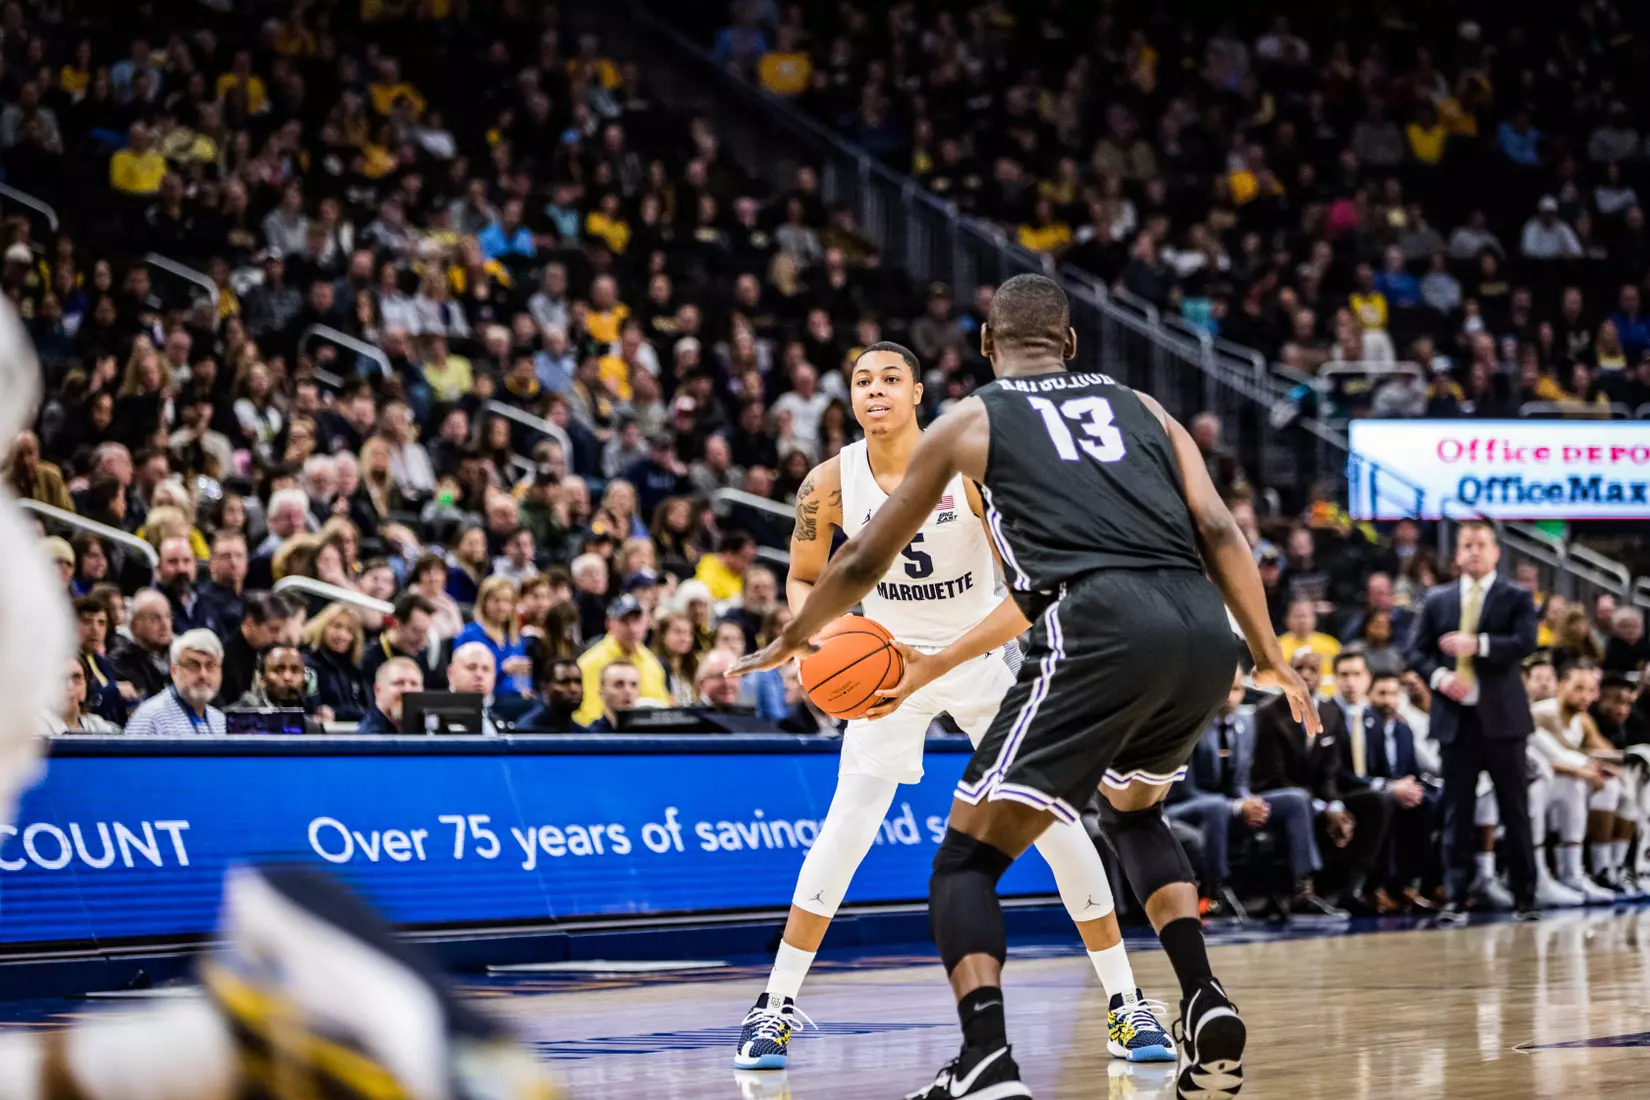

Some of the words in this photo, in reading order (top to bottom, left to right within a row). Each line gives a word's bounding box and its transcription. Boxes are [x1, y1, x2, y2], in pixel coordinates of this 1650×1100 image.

[1026, 395, 1127, 463] 13
[1436, 437, 1551, 464] Office
[1457, 474, 1648, 506] OfficeMax
[901, 532, 934, 579] 5
[876, 571, 974, 601] MARQUETTE
[308, 816, 428, 863] Over
[438, 814, 501, 859] 75
[510, 823, 632, 871] years
[641, 806, 685, 853] of
[695, 808, 828, 857] saving
[874, 802, 922, 845] nd
